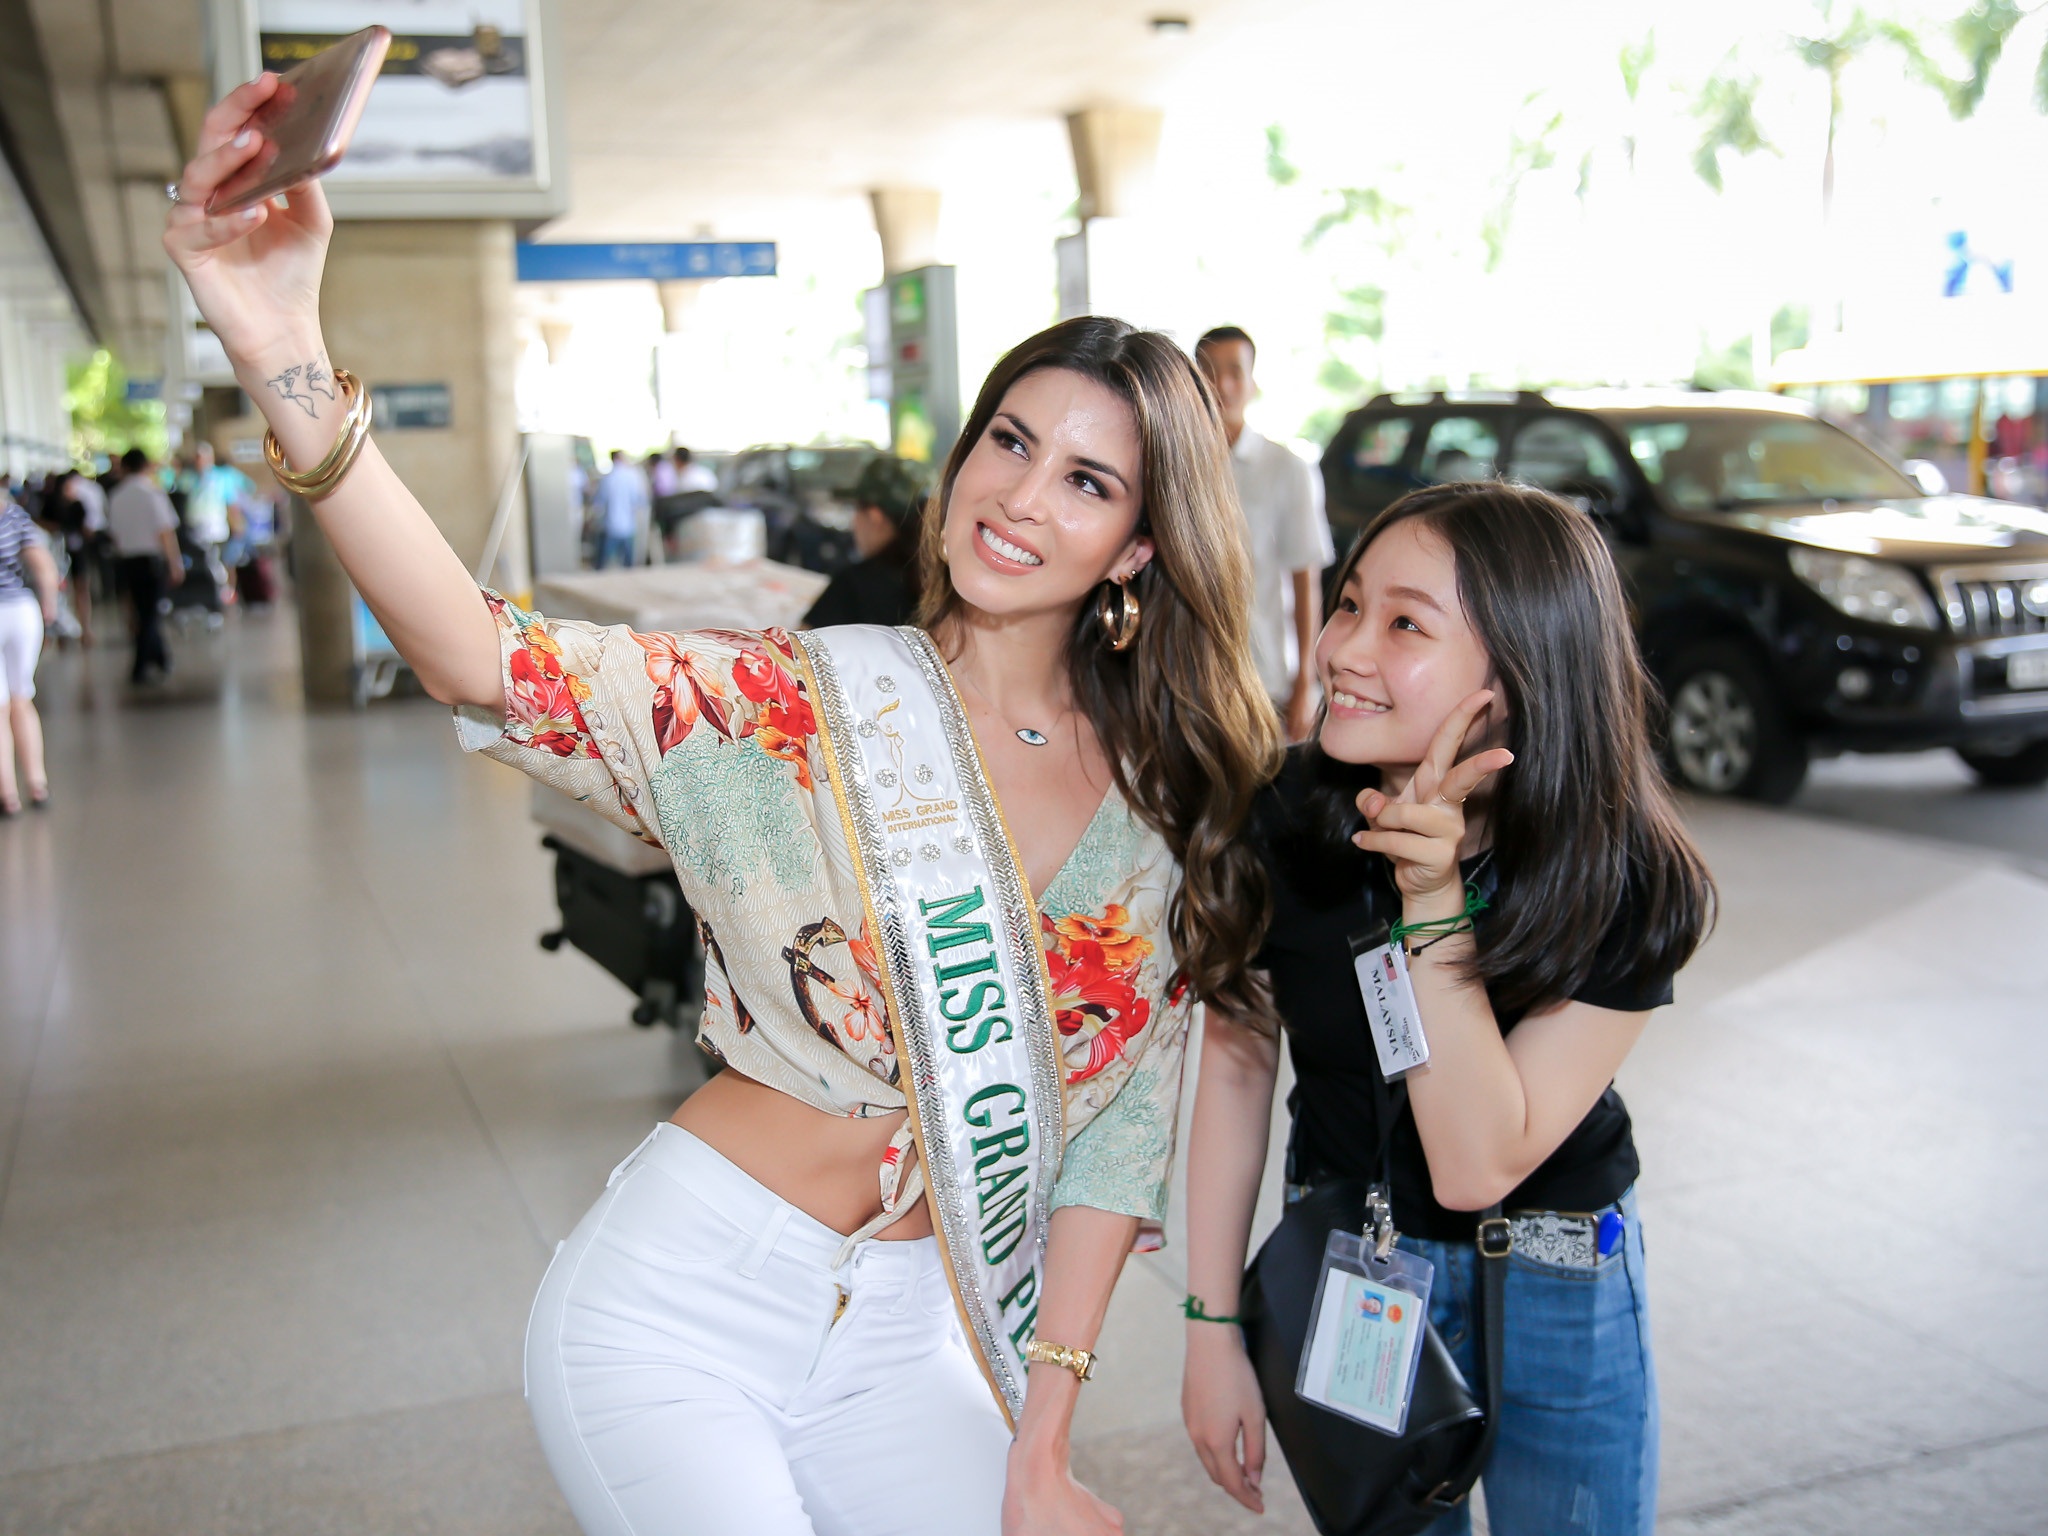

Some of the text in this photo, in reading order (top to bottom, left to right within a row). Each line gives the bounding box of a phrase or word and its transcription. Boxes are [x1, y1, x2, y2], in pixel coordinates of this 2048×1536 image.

[881, 799, 959, 823] MISS GRAND
[887, 814, 958, 834] INTERNATIONAL
[1371, 970, 1399, 1056] MALAYSIA
[918, 885, 1039, 1376] MISS GRAND PE
